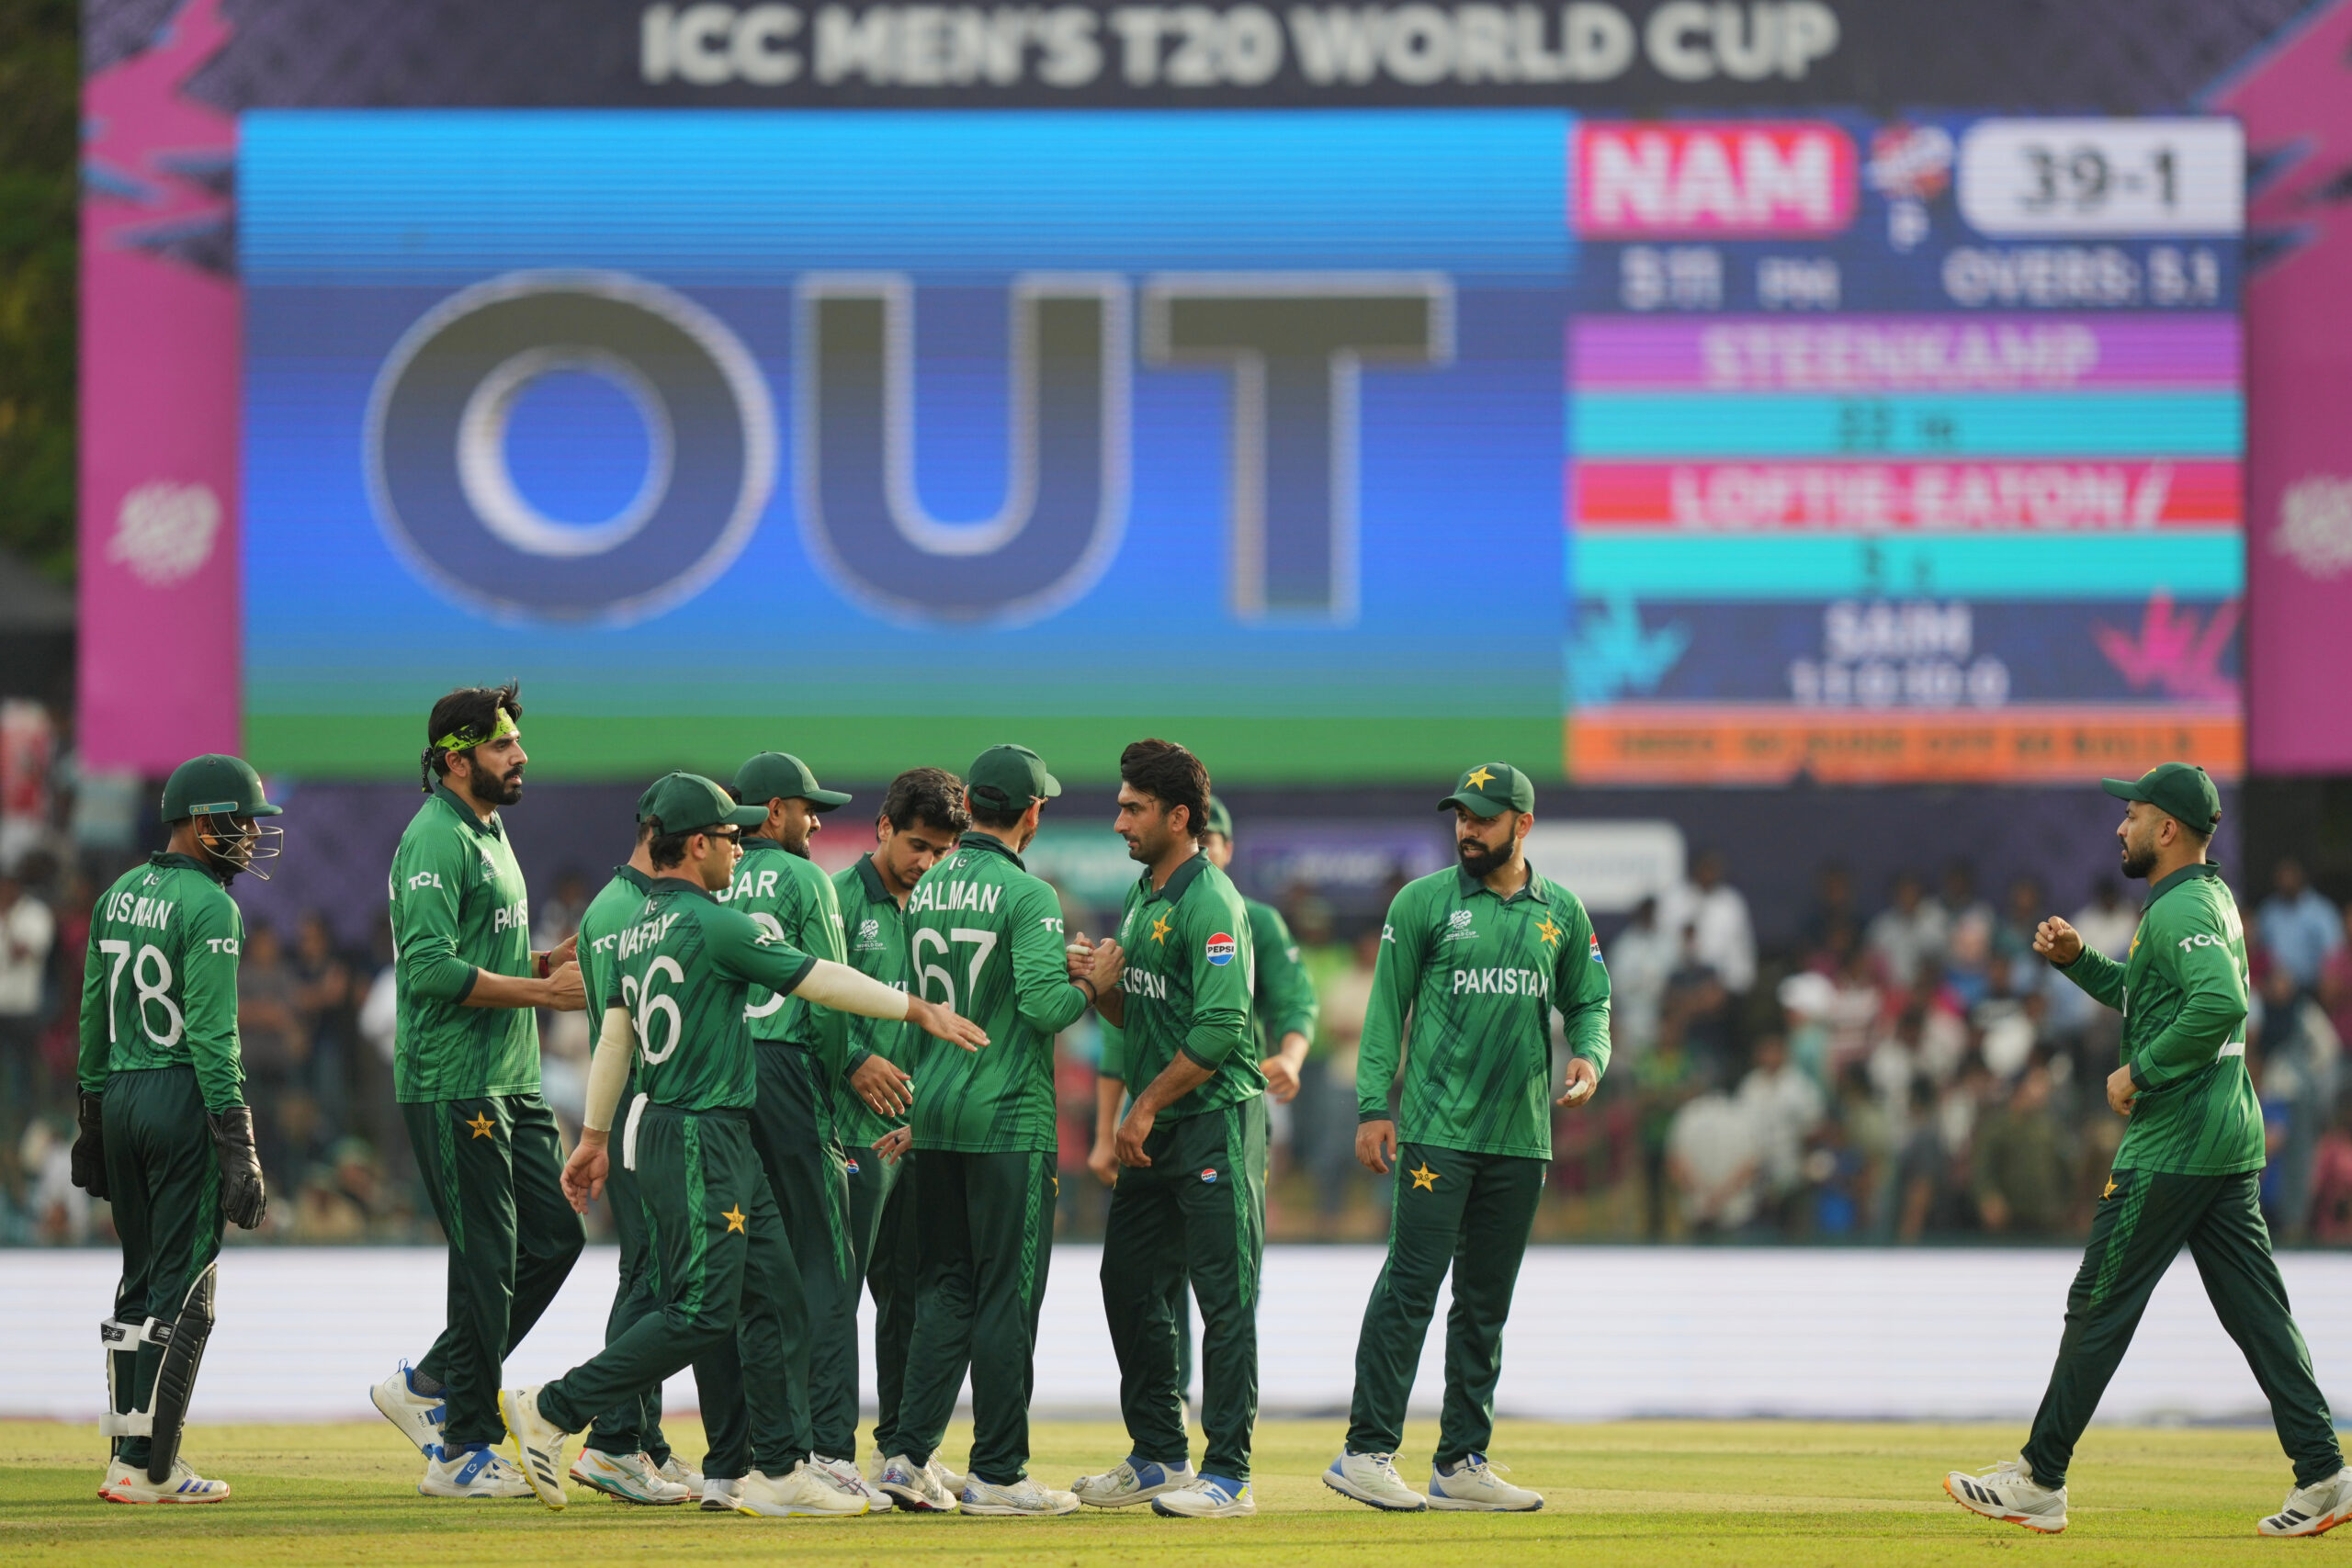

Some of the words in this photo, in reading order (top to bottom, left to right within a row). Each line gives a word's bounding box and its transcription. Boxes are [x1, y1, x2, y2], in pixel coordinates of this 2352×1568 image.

[642, 4, 803, 85] ICC
[814, 5, 1102, 86] MEN'S
[1109, 5, 1283, 85] T20
[1289, 5, 1636, 85] WORLD
[1645, 3, 1838, 81] CUP
[1591, 132, 1836, 225] NAM
[2018, 143, 2178, 211] 39-1
[364, 268, 1457, 628] OUT
[1825, 600, 1973, 660] SAIM
[408, 872, 443, 891] TCL
[713, 870, 778, 903] BAR
[909, 880, 1001, 915] SALMAN
[107, 891, 174, 931] USMAN
[207, 938, 239, 955] TCL
[617, 911, 680, 962] NAFAY
[1207, 945, 1236, 954] PEPSI
[2178, 933, 2227, 953] TCL
[99, 939, 185, 1048] 78
[912, 927, 997, 1020] 67
[1453, 967, 1549, 1002] PAKISTAN
